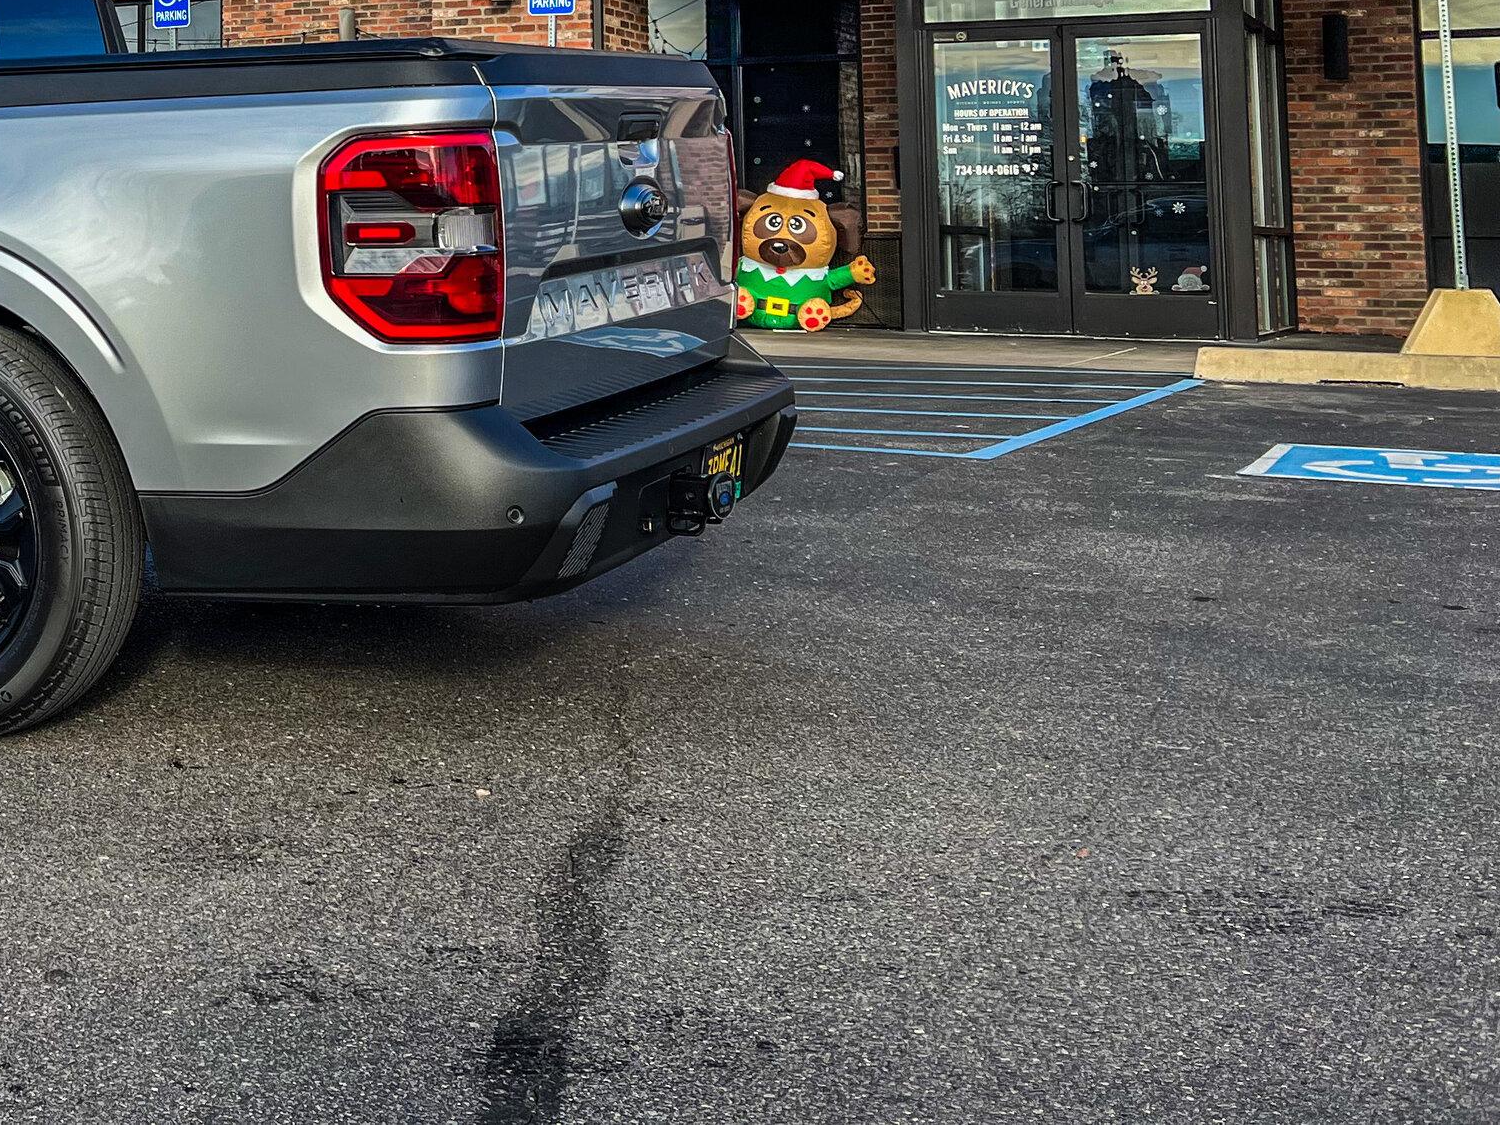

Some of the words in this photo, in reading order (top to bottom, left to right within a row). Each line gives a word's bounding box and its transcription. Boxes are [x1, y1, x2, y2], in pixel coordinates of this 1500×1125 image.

[155, 10, 187, 22] PARKING
[946, 79, 1035, 100] MAVERICK'S
[954, 109, 978, 118] HOURS
[979, 109, 988, 117] OF
[989, 108, 1029, 117] OPERATION
[542, 260, 708, 326] MAVERICK
[55, 501, 70, 566] PRIMACY
